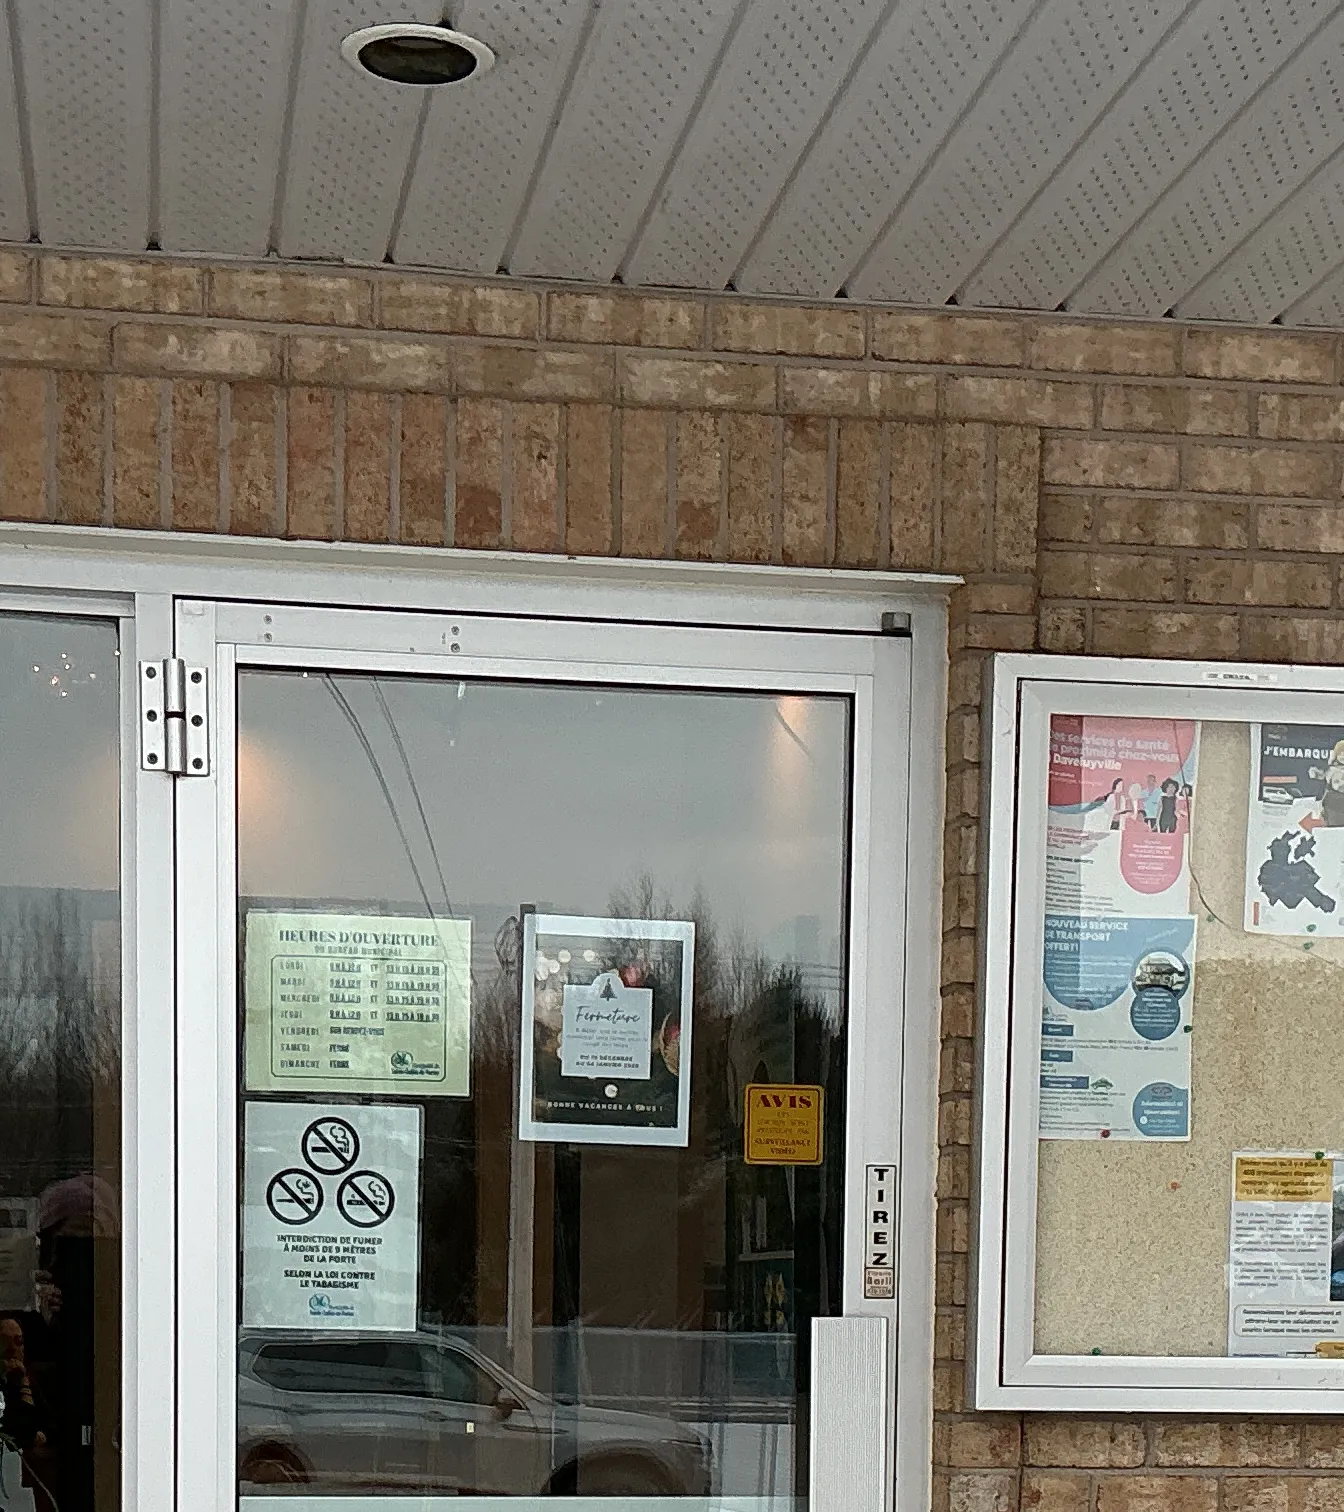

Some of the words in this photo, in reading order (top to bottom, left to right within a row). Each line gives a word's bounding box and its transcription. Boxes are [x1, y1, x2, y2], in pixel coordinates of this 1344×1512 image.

[1264, 745, 1333, 760] J'EMBARQU
[1054, 753, 1122, 770] Daveluyville
[279, 930, 336, 943] HEURES
[339, 932, 439, 947] D'OUVERTURE
[576, 1005, 640, 1024] Fermeture
[756, 1094, 812, 1108] AVIS
[873, 1168, 890, 1266] TIREZ
[277, 1235, 337, 1244] INTERDICTION
[340, 1236, 351, 1244] DE
[353, 1237, 382, 1245] FUMER
[291, 1245, 320, 1253] MOINS
[304, 1255, 314, 1263] DE
[317, 1255, 327, 1263] LA
[329, 1256, 356, 1264] PORTE
[284, 1270, 311, 1278] SELON
[326, 1271, 338, 1279] LOI
[341, 1272, 375, 1280] CONTRE
[312, 1280, 359, 1289] TABAGISME
